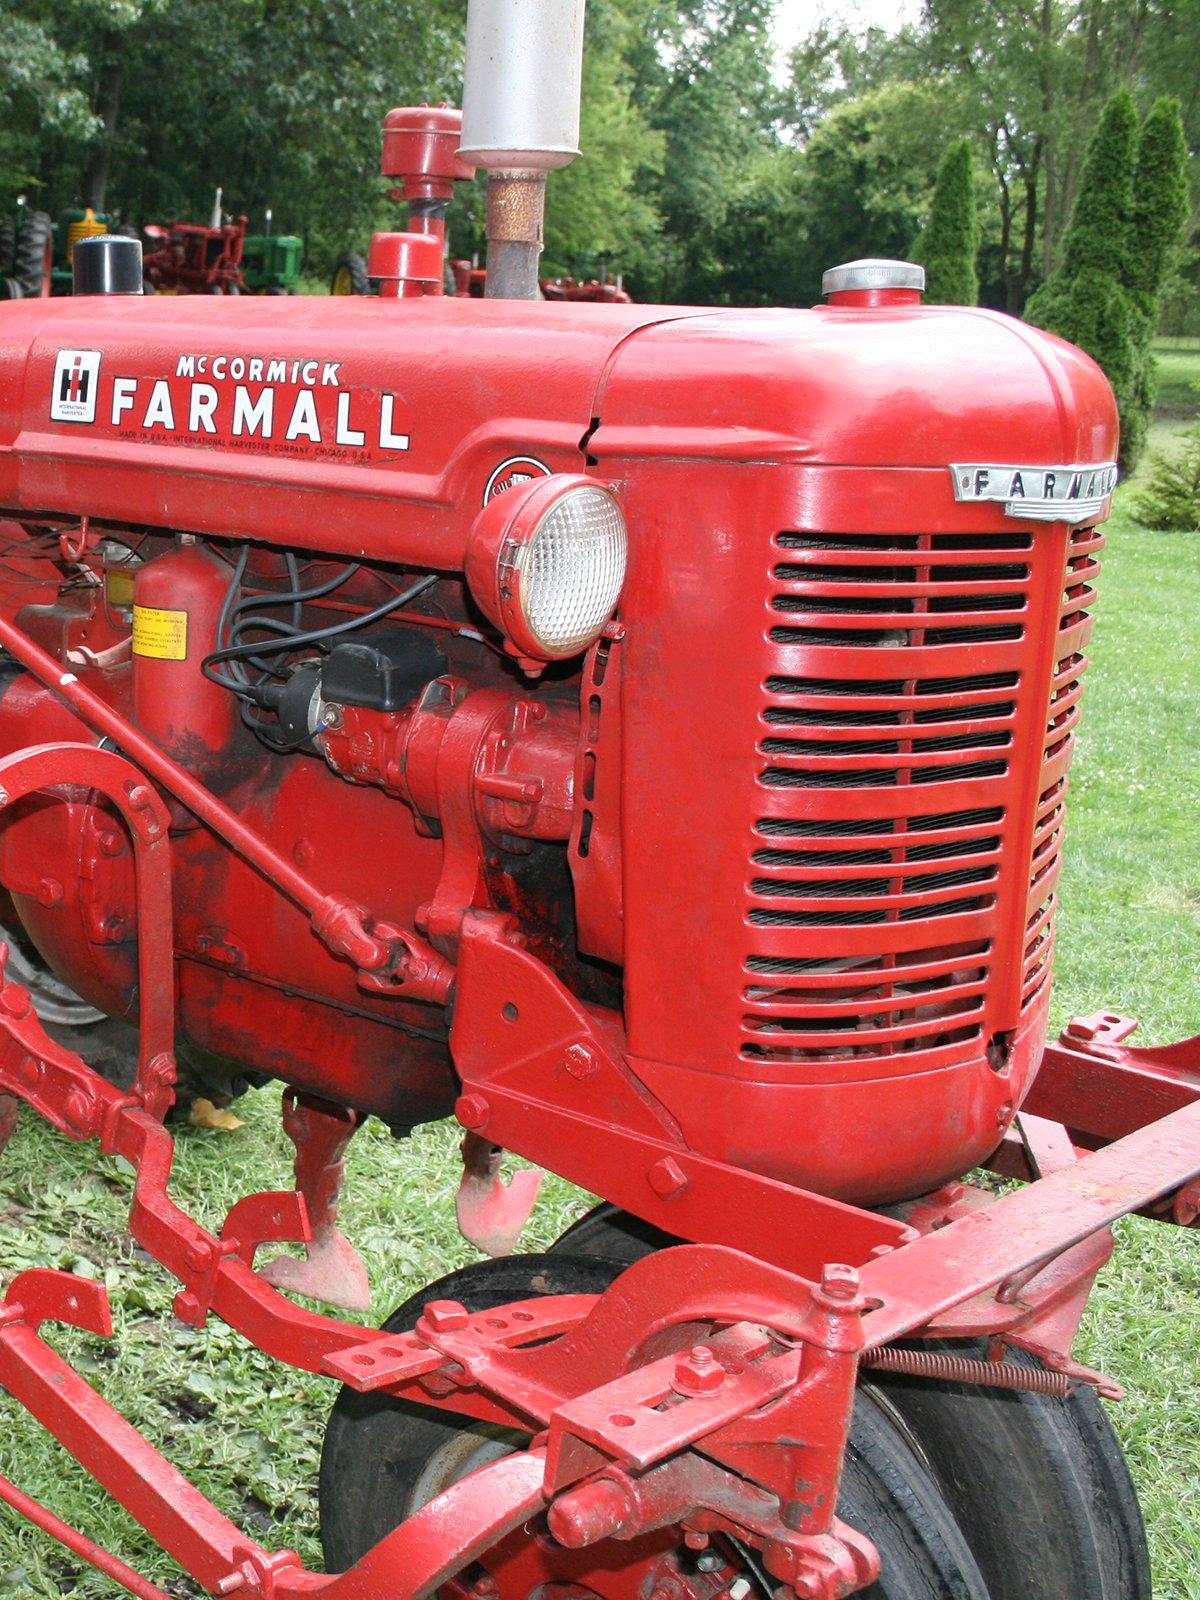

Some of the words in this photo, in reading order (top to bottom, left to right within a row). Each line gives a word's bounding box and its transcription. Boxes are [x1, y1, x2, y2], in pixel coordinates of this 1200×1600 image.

[111, 375, 410, 450] FARMALL
[119, 430, 137, 439] MADE
[140, 432, 148, 440] IN
[173, 434, 226, 446] INTERNATIONAL
[230, 440, 270, 451] HARVESTER
[275, 444, 309, 455] COMPANY
[315, 447, 348, 458] CHICAGO
[974, 467, 1115, 500] FARMALL
